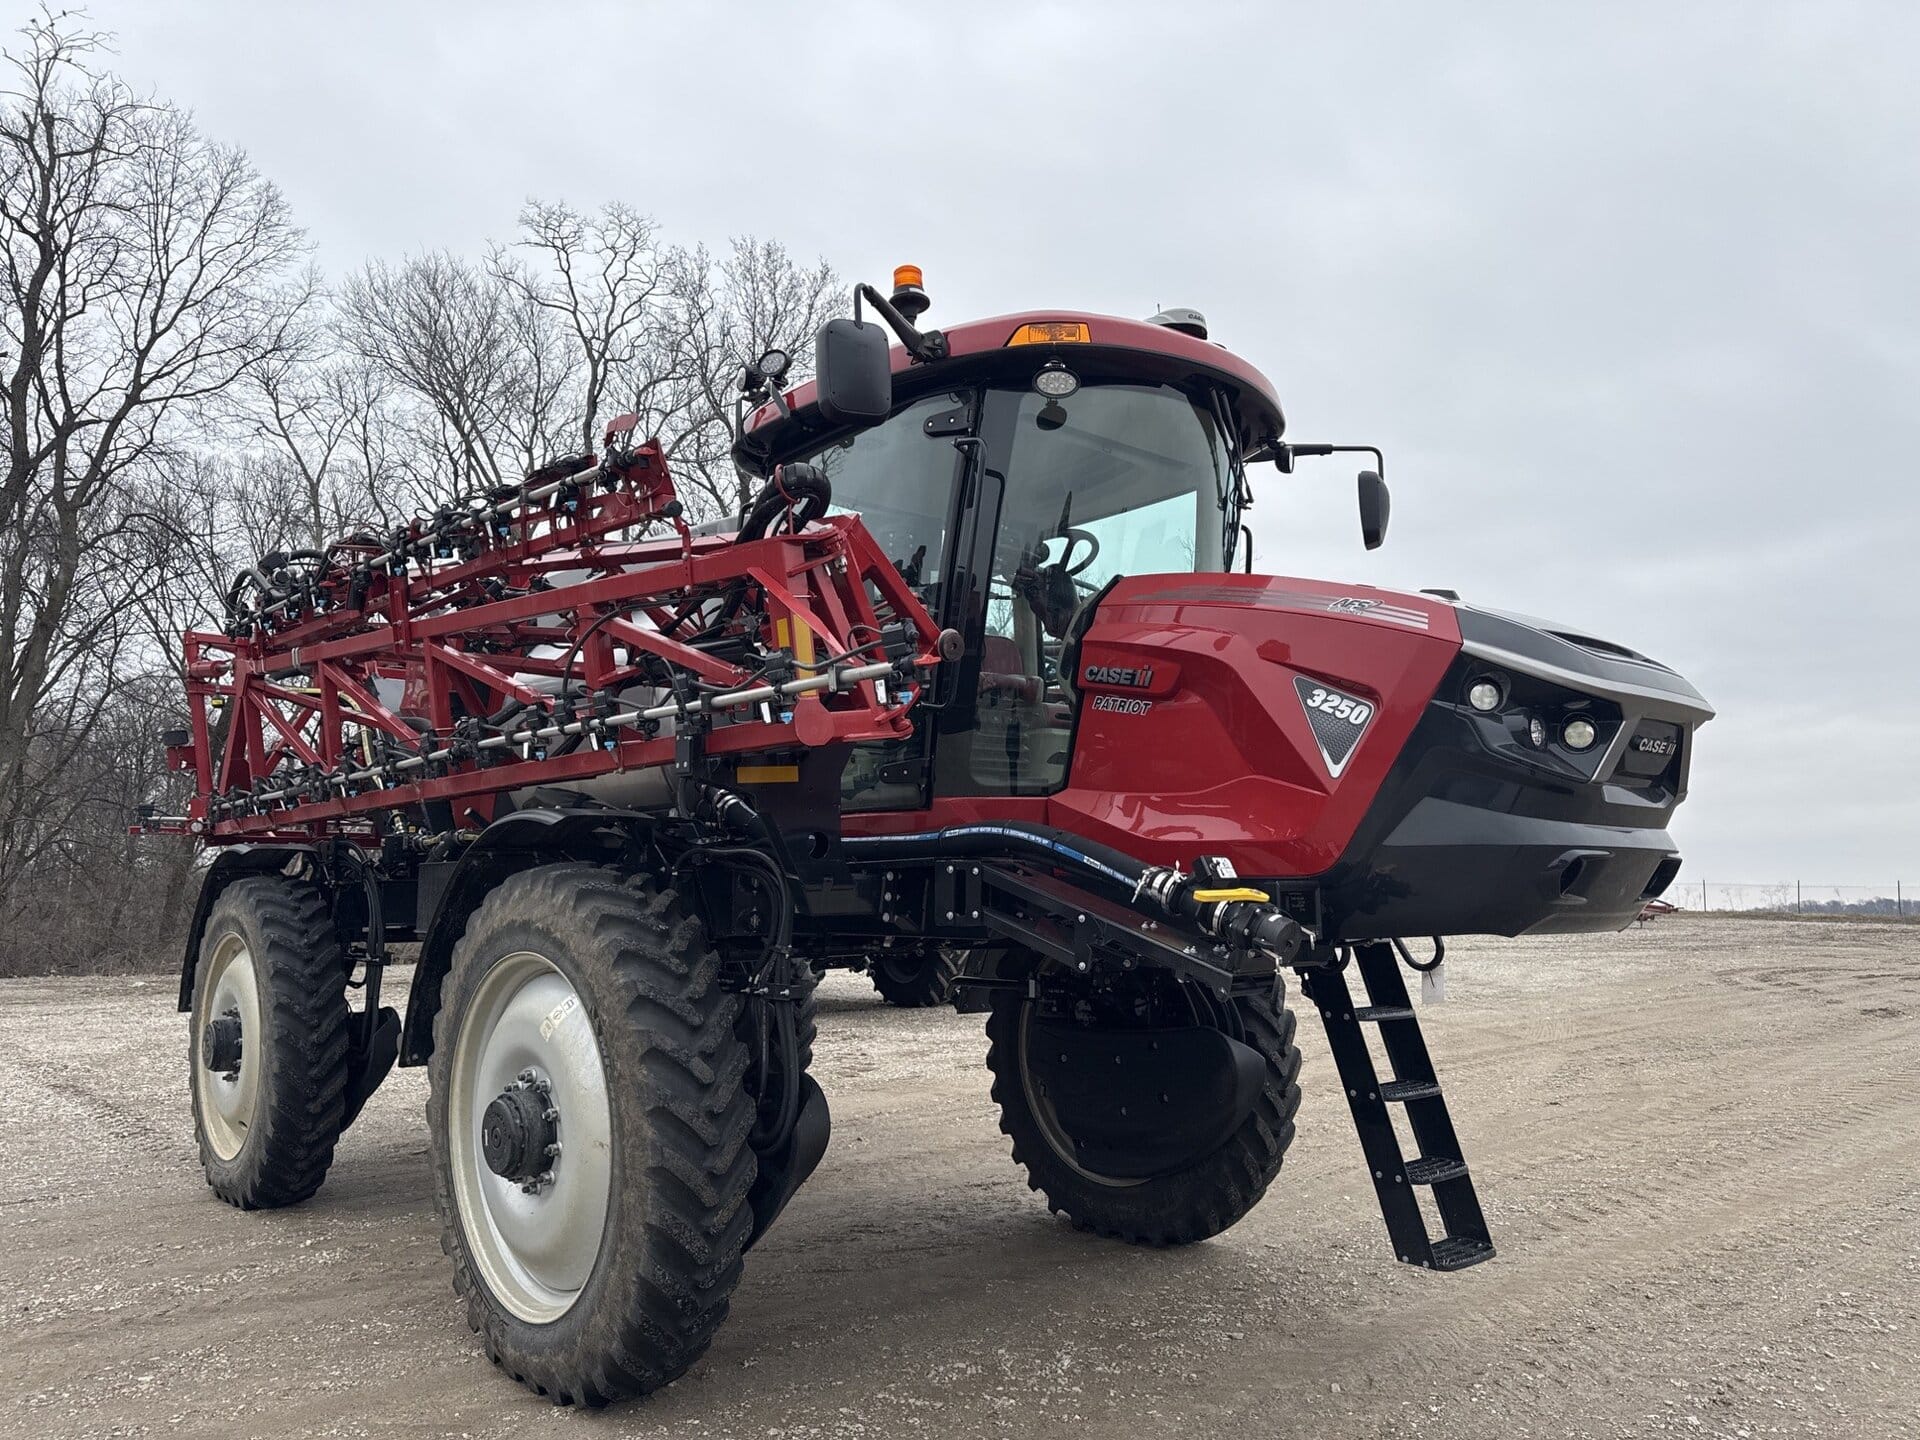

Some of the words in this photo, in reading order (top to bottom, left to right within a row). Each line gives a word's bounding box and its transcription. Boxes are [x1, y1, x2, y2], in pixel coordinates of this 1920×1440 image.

[1332, 597, 1371, 610] AFS
[1085, 665, 1131, 685] CASE
[1092, 696, 1152, 715] PATRIOT
[1306, 688, 1370, 725] 3250
[1639, 738, 1667, 752] CASE
